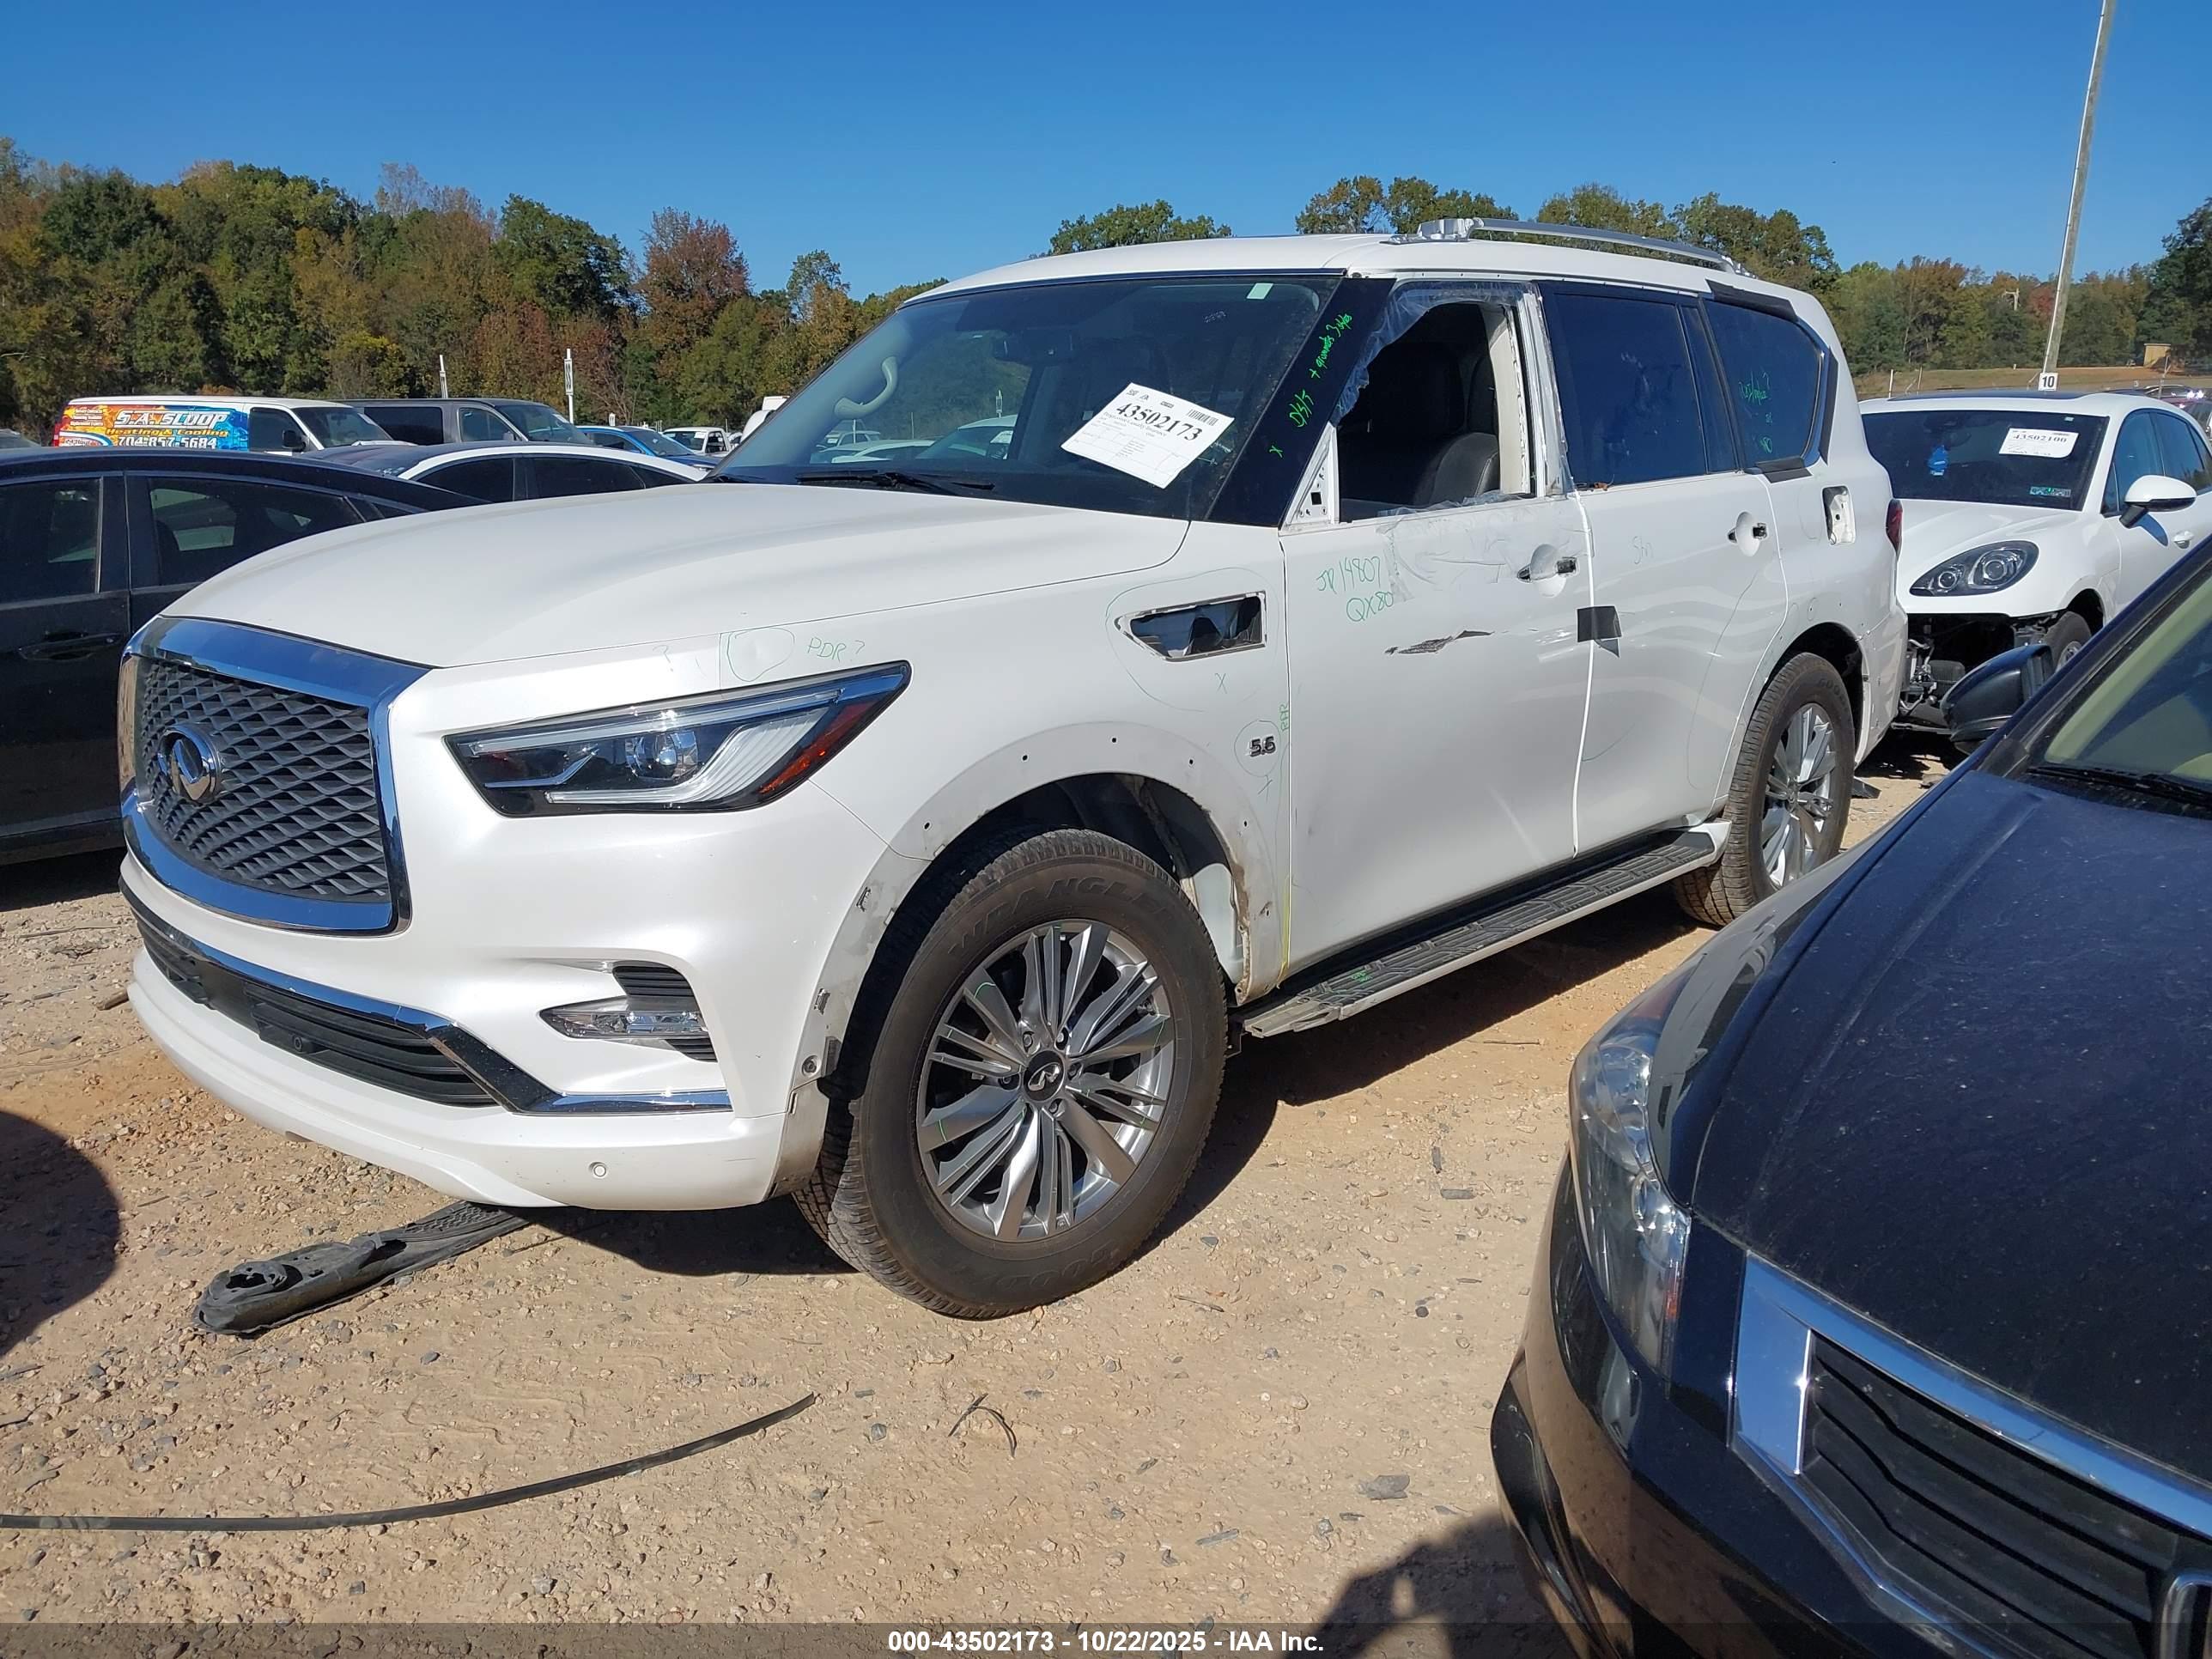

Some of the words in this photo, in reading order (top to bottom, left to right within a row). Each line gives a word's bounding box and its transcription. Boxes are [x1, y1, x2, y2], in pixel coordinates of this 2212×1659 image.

[2042, 375, 2056, 388] 10
[1116, 402, 1203, 441] 43502173
[1346, 591, 1395, 622] QX80
[1249, 735, 1277, 757] 5.6
